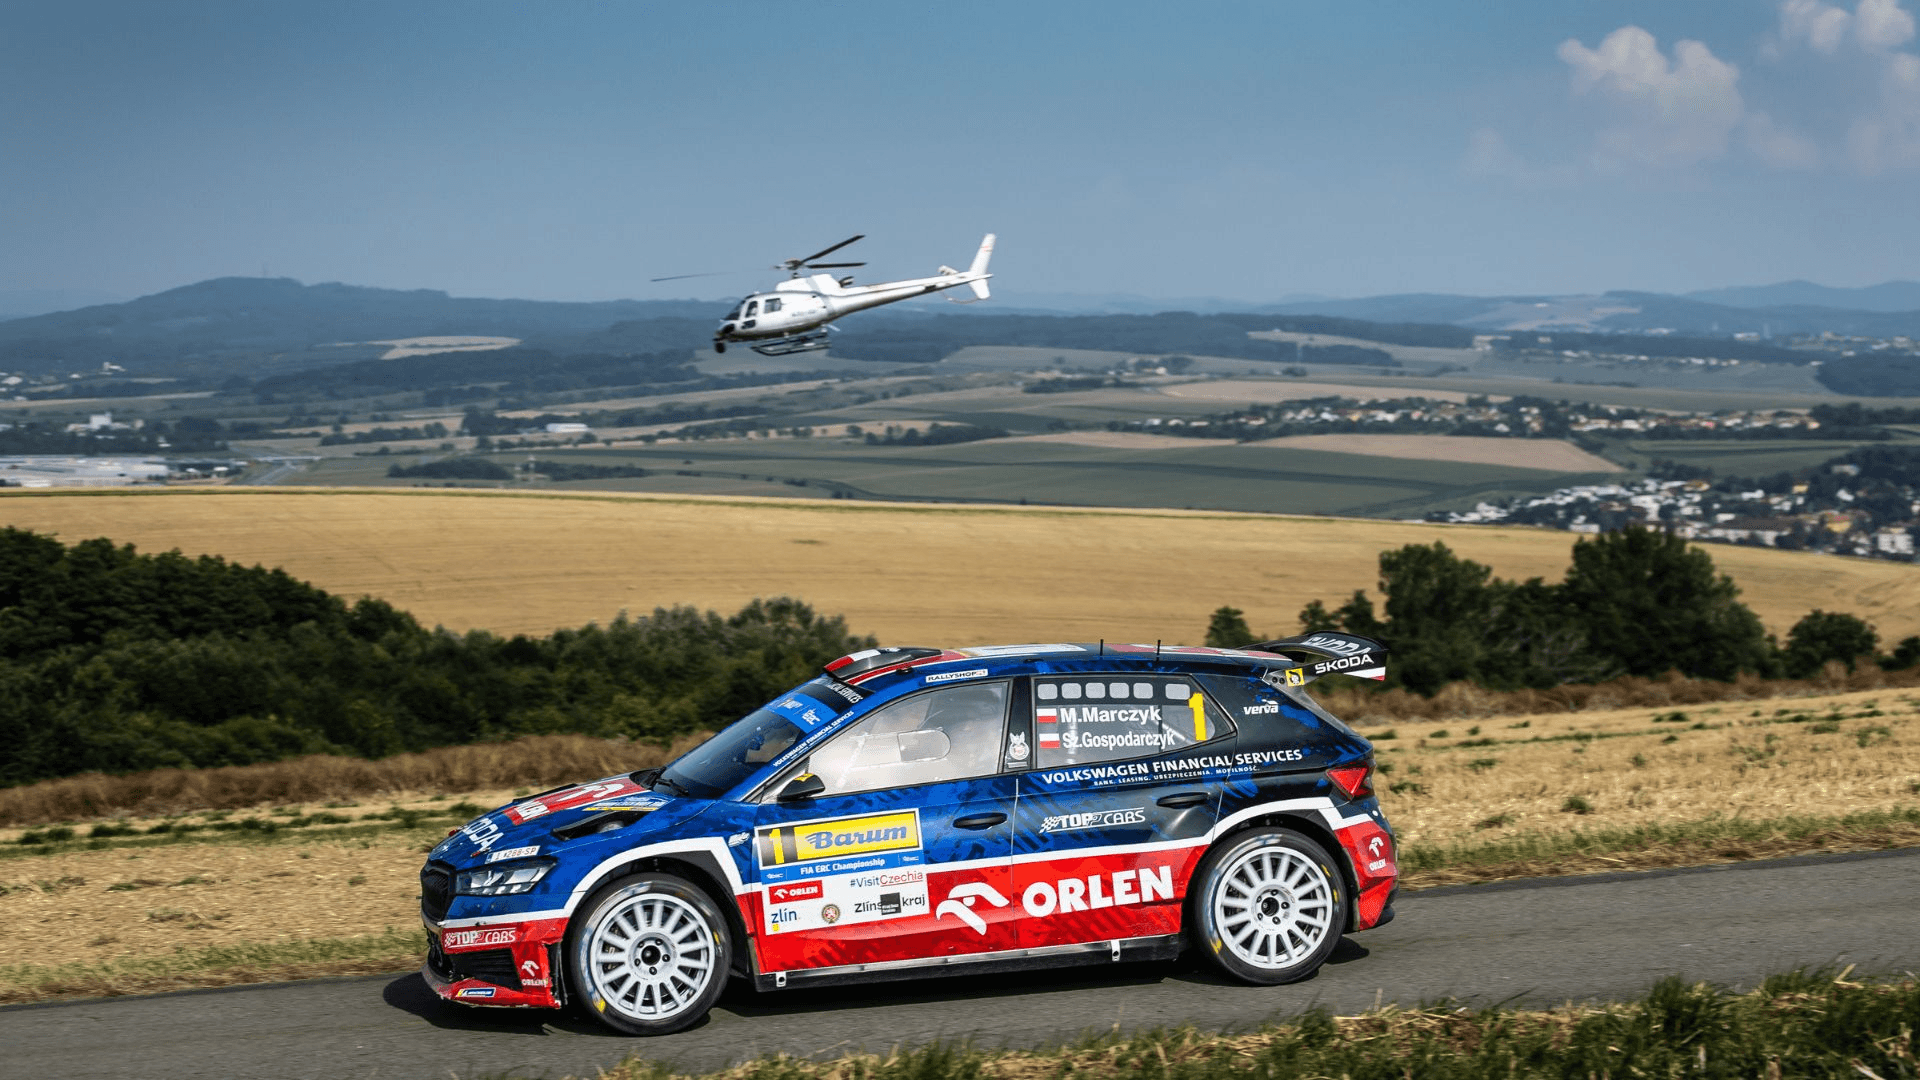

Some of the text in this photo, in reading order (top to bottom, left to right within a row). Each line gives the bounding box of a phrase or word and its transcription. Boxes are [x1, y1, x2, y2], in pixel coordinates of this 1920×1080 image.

[1060, 705, 1162, 726] M.Marczyk
[1188, 693, 1207, 741] 1
[1243, 703, 1279, 715] verva
[1062, 728, 1175, 751] Sz.Gospodarczyk
[1041, 749, 1302, 785] VOLKSWAGEN FINANCIAL SERVICES
[1060, 810, 1145, 828] TOP CARS
[460, 818, 504, 852] ODA
[769, 828, 784, 865] 1
[806, 826, 907, 850] Barum
[800, 858, 886, 875] FIA ERC Championship
[850, 871, 923, 888] #VisitCzechia
[789, 886, 819, 897] ORLEN
[902, 894, 926, 906] kraj
[1022, 866, 1174, 917] ORLEN
[771, 908, 798, 924] zlín
[485, 930, 516, 943] CARS
